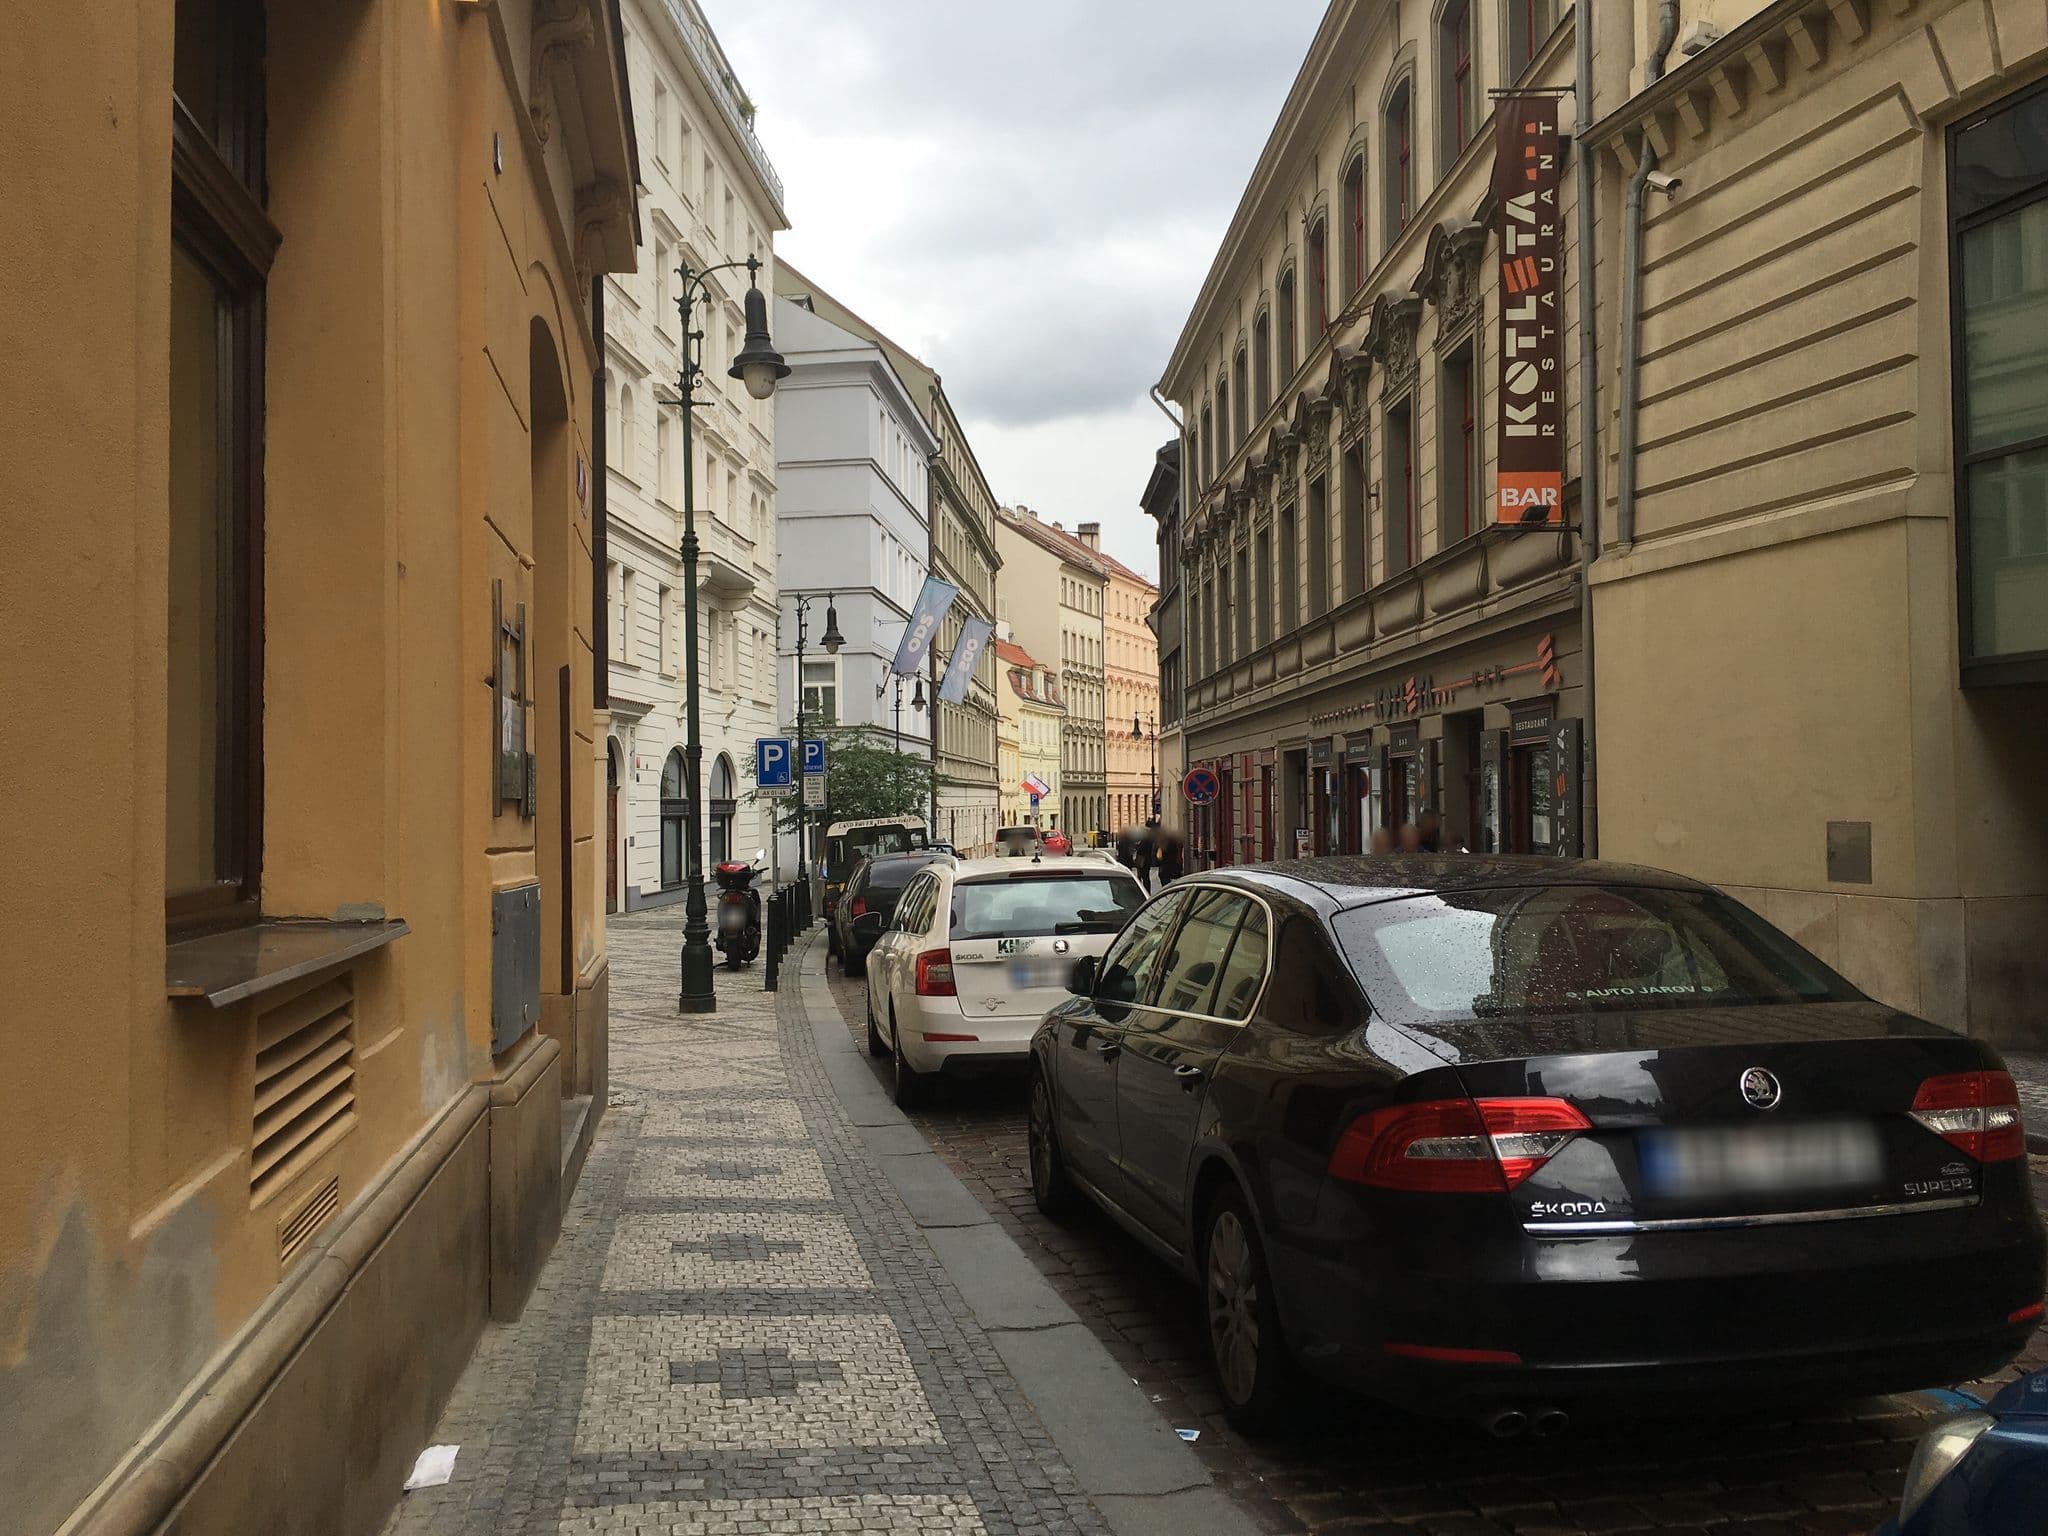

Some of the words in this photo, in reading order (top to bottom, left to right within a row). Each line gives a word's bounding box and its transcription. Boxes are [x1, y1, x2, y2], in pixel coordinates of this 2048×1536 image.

[1539, 120, 1556, 437] RESTAURANT
[1504, 190, 1540, 437] KOTLETA
[1500, 487, 1558, 508] BAR
[907, 613, 935, 653] ODS
[1515, 717, 1548, 731] RESTAURANT
[764, 744, 784, 772] P
[805, 743, 819, 764] P
[1586, 987, 1635, 998] AUTO
[1639, 985, 1696, 995] JAROV
[1530, 1201, 1607, 1218] ŠKODA
